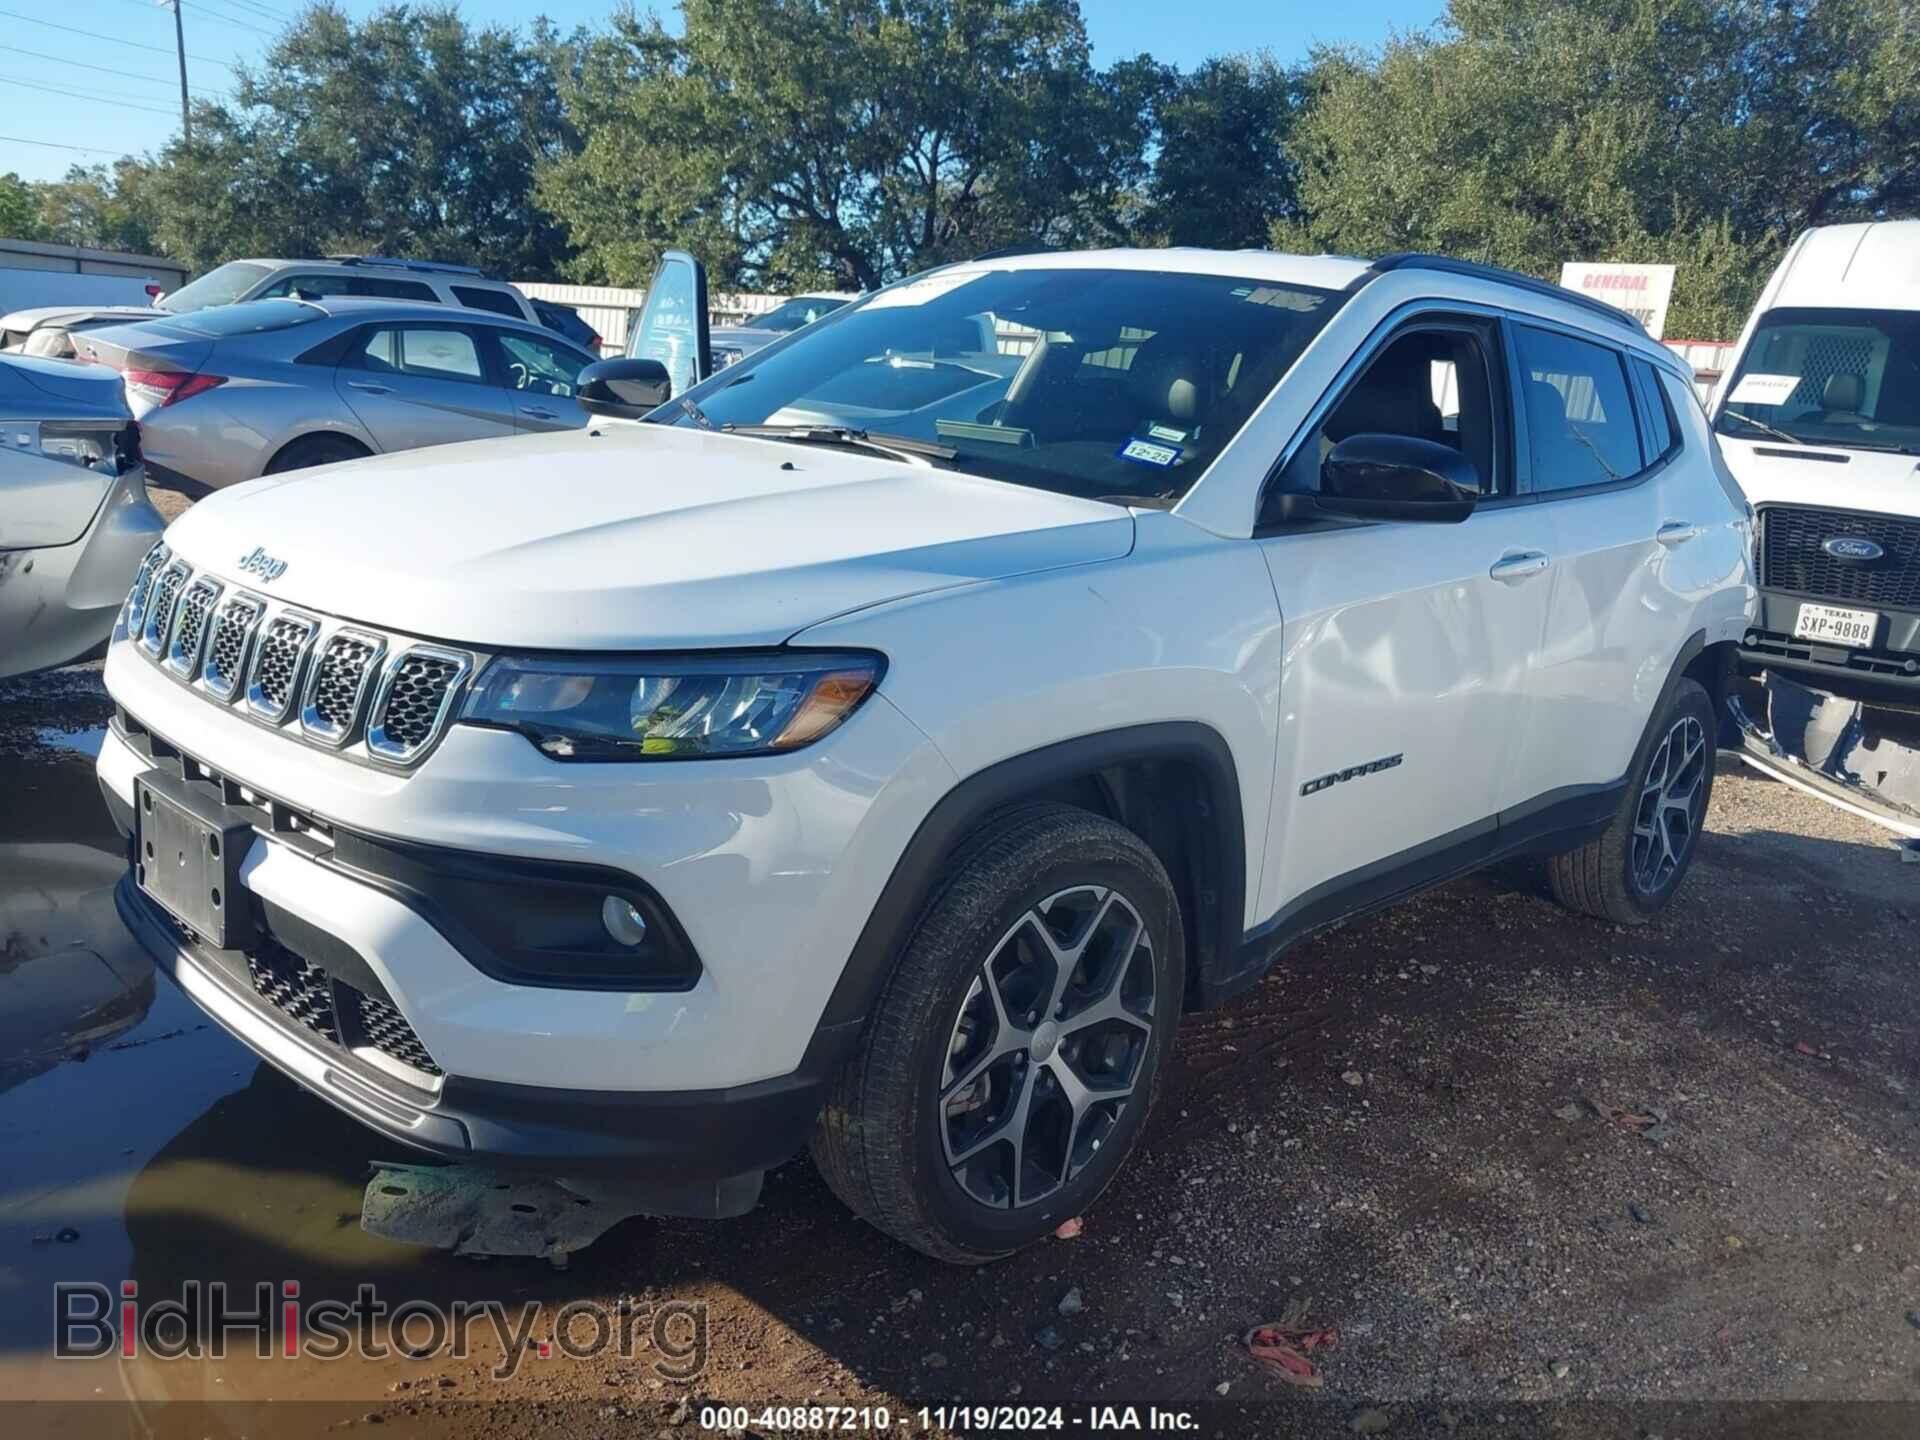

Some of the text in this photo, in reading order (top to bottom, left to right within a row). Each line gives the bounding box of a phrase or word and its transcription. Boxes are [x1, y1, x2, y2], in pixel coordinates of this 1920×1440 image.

[1583, 274, 1648, 291] GENERAL
[1838, 543, 1870, 556] Ford
[239, 547, 288, 584] Jeep
[1824, 609, 1852, 619] TEXAS
[1299, 753, 1403, 796] COMPASS
